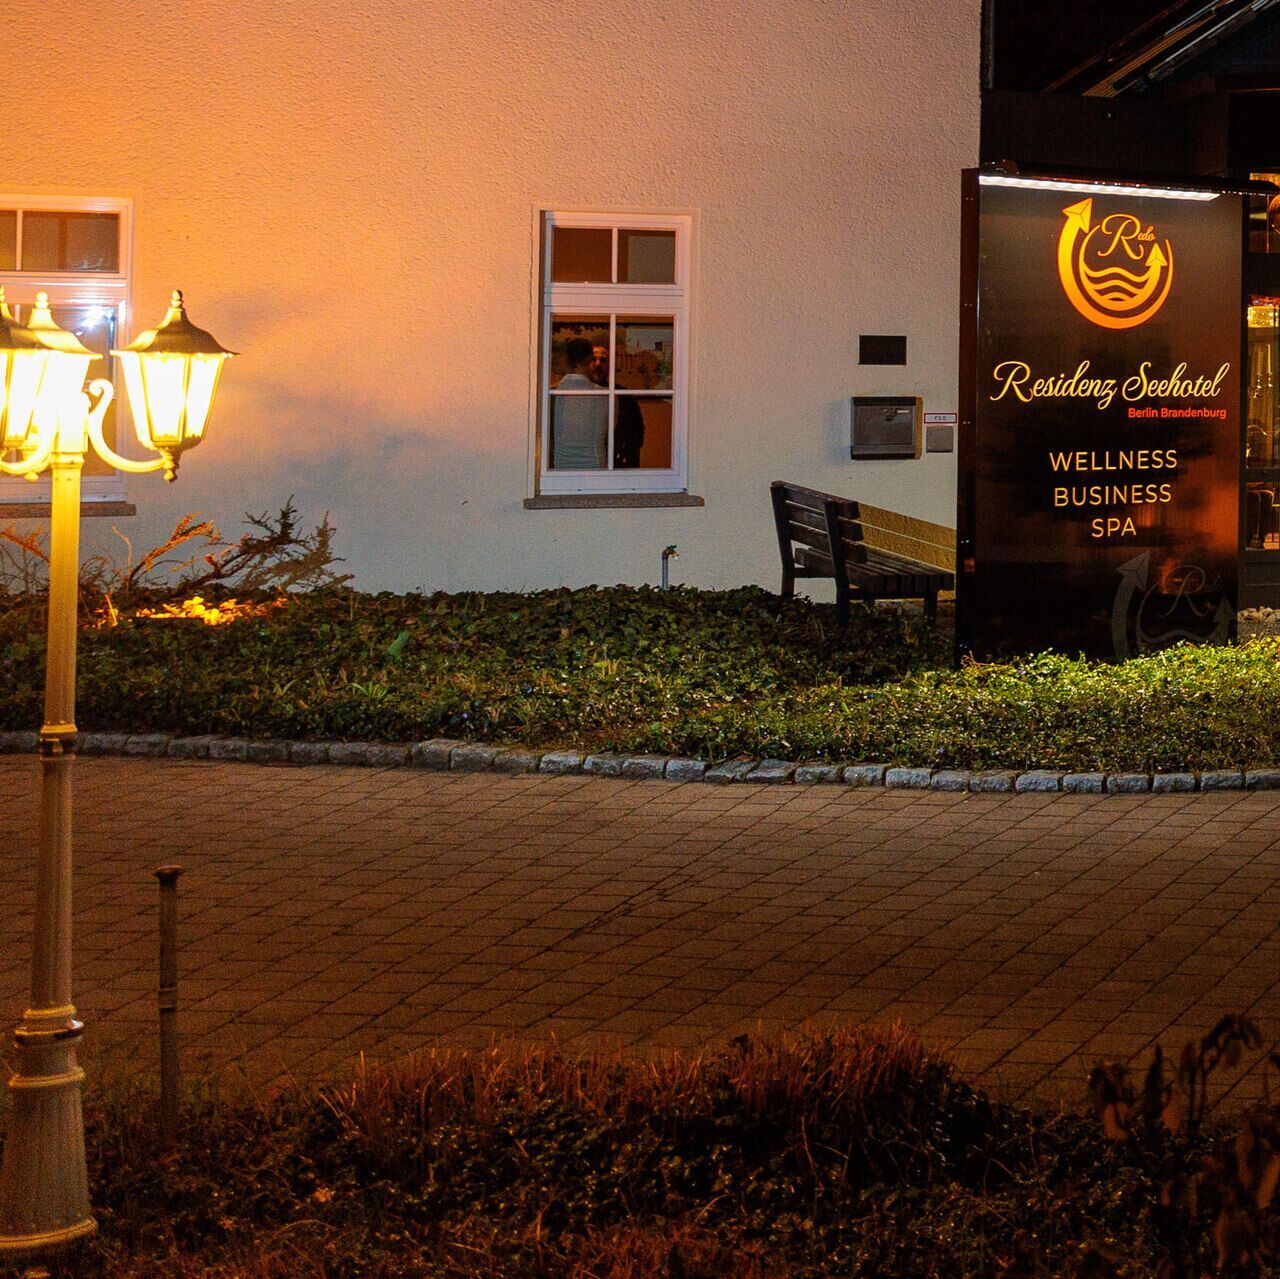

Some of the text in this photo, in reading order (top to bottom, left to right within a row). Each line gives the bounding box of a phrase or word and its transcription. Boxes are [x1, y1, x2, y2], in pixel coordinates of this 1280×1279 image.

[989, 360, 1230, 410] Residenz Seehotel
[1128, 407, 1227, 420] Berlin Brandenburg
[1049, 449, 1178, 472] WELLNESS
[1054, 483, 1172, 507] BUSINESS
[1091, 517, 1137, 538] SPA
